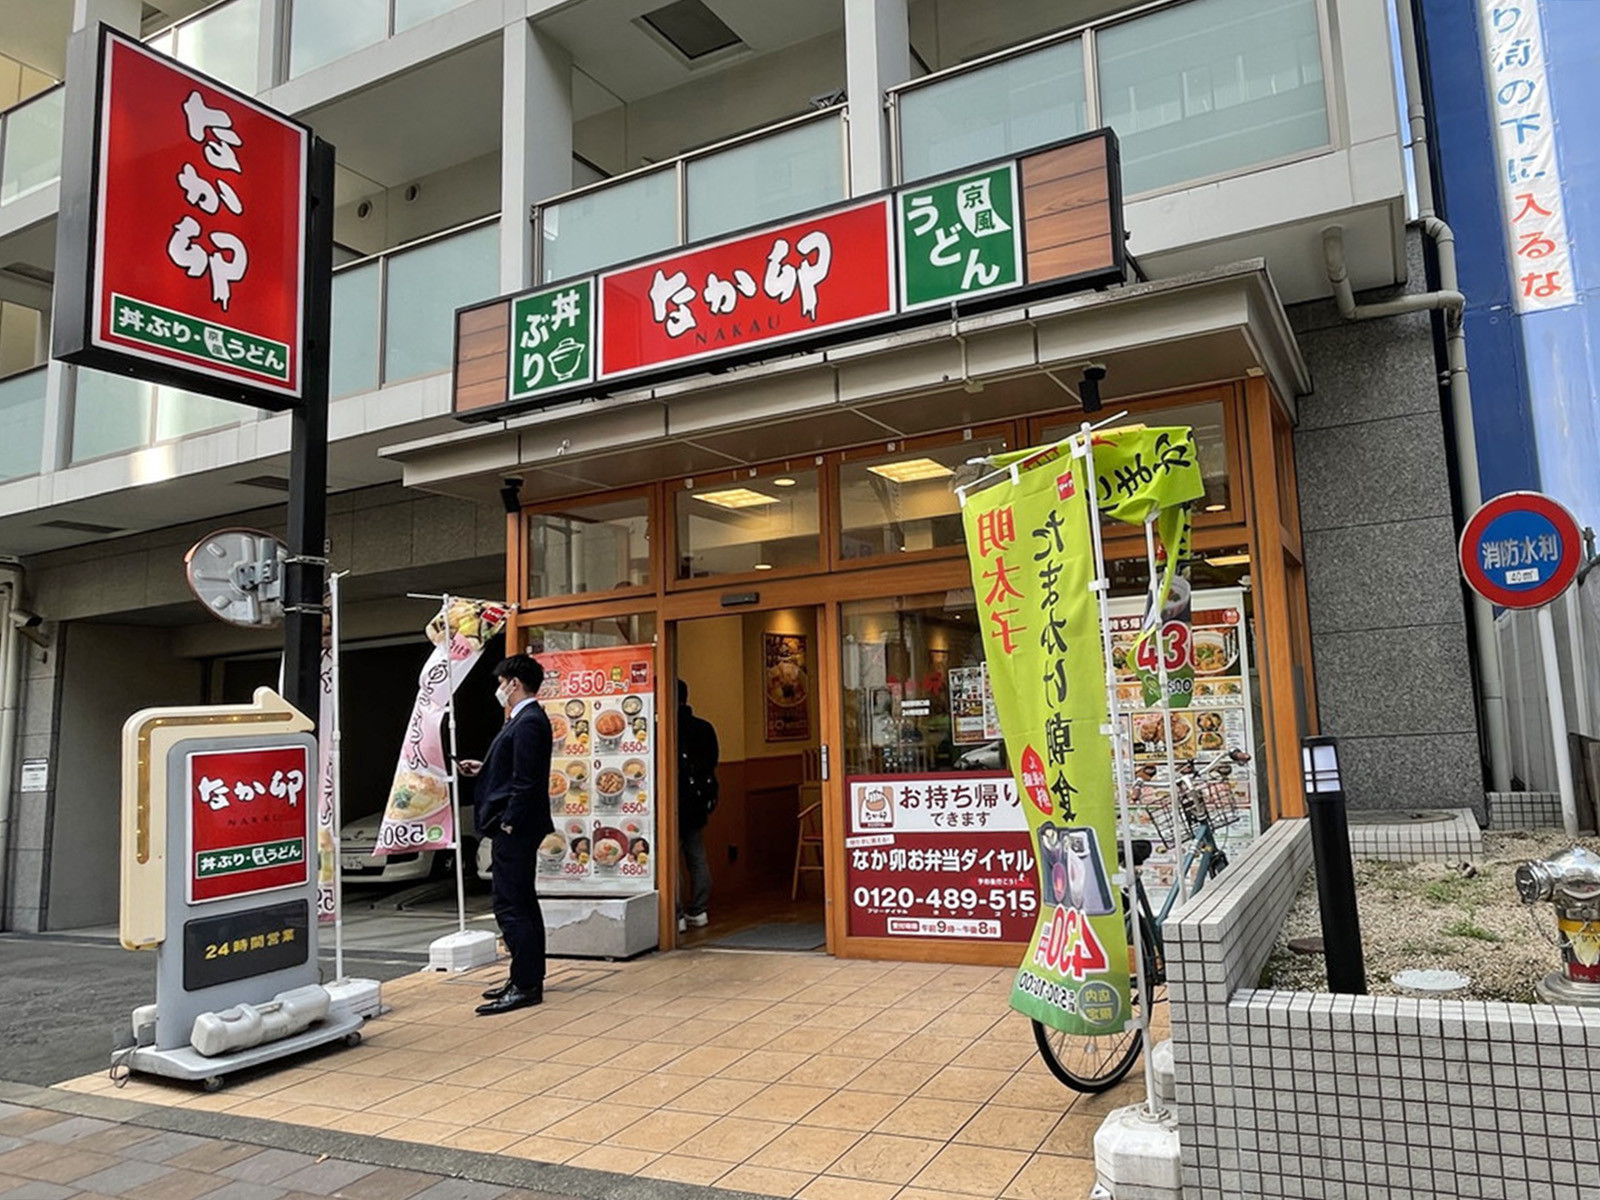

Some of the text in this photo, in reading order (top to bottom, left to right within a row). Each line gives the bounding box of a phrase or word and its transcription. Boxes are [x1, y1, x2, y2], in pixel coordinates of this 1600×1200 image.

[167, 91, 249, 312] なか卯
[963, 185, 996, 234] 京風
[907, 195, 1000, 290] うどん
[649, 238, 832, 338] なか卯
[695, 315, 781, 345] NAKAU
[1482, 533, 1559, 570] 消防水利
[198, 770, 303, 810] なか卯
[899, 784, 1020, 809] お持ち帰り
[930, 812, 991, 827] できます
[852, 848, 1035, 872] なか卯お弁当ダイヤル
[853, 887, 1037, 911] 0120-489-515
[204, 929, 294, 960] 24時間営業
